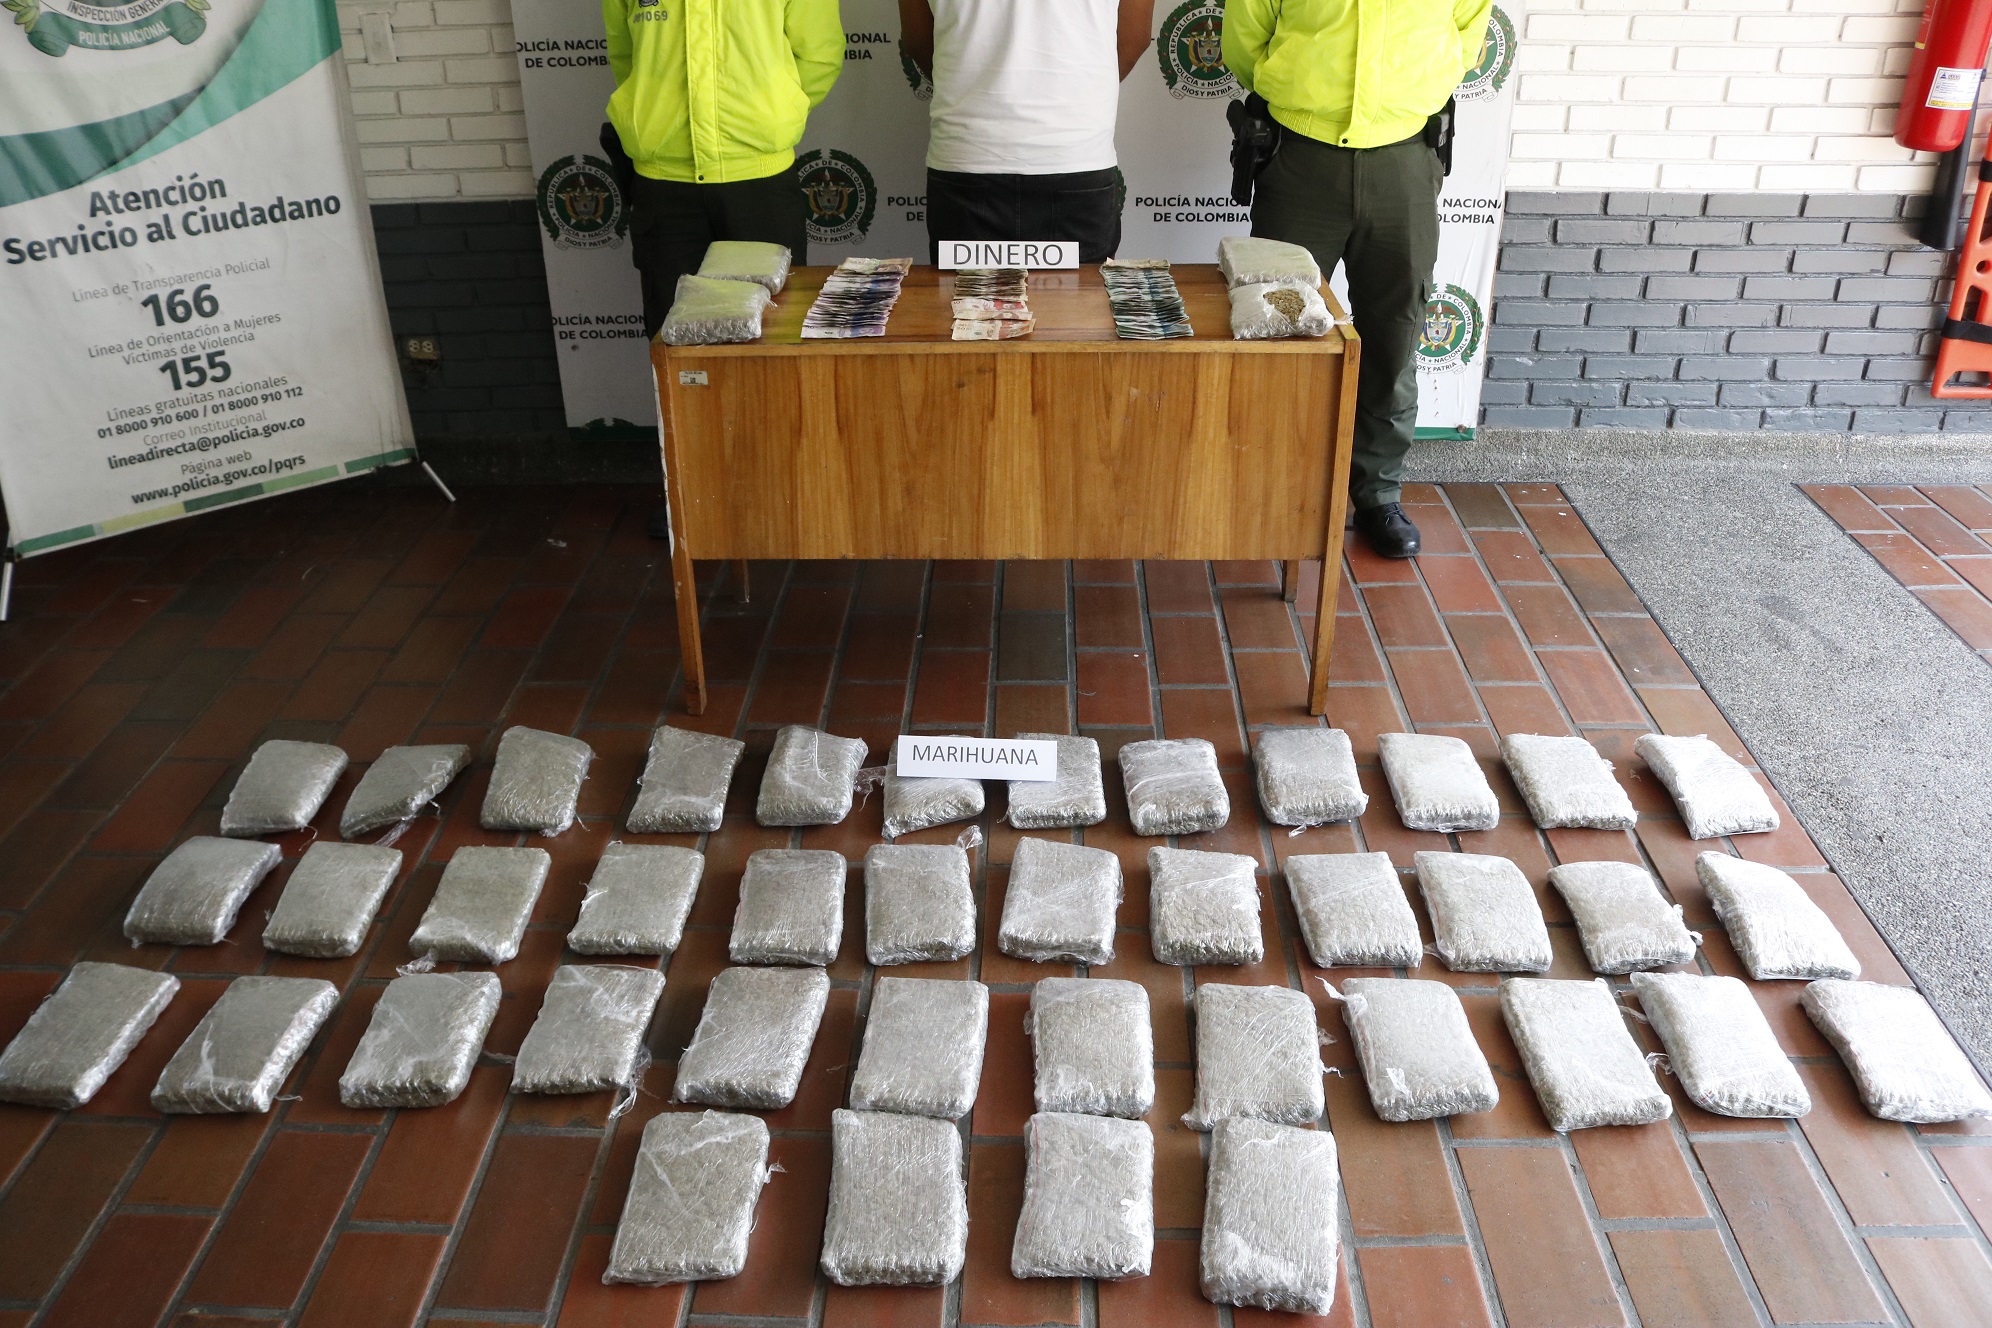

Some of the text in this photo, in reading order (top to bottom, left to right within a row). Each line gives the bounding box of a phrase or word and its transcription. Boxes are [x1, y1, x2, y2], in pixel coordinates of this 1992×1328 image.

[121, 20, 171, 45] NACIONAL
[845, 32, 892, 44] IONAL
[1488, 19, 1505, 57] OLOMBIA
[515, 37, 608, 53] OLICÍA NACIO
[525, 55, 611, 69] DE COLOMB
[1462, 66, 1502, 90] NACIONAL
[1181, 84, 1199, 96] DIOS
[1206, 85, 1233, 97] PATRIA
[1460, 88, 1488, 100] PATRIA
[89, 172, 227, 218] Atención
[594, 169, 620, 207] COLOMBIA
[840, 164, 865, 203] COLOMBIA
[887, 196, 927, 207] POLIC
[1135, 194, 1191, 207] POLICÍA
[587, 215, 619, 238] NACIONAL
[829, 211, 864, 234] NACIONAL
[906, 211, 924, 222] DE
[1153, 212, 1250, 223] DE COLOMBIA
[2, 195, 341, 265] Servicio al Ciudadano
[564, 236, 582, 247] DIOS
[588, 235, 613, 247] PATRIA
[829, 231, 855, 243] PATRIA
[953, 243, 1064, 266] DINERO
[112, 283, 129, 296] de
[132, 266, 222, 292] Transparencia
[225, 257, 271, 276] Policial
[141, 283, 220, 327] 166
[1453, 298, 1472, 335] COLOMBIA
[127, 338, 143, 351] de
[146, 323, 221, 347] Orientación
[223, 321, 231, 333] a
[234, 311, 282, 330] Mujeres
[551, 313, 645, 326] OLICÍA NACION
[181, 342, 196, 355] de
[199, 331, 256, 351] Violencia
[559, 328, 649, 340] DE COLOMBIA
[1433, 342, 1467, 363] NACIONAL
[159, 350, 232, 391] 155
[1432, 362, 1457, 372] PATRIA
[107, 375, 288, 422] Líneas gratuitas nacionales
[97, 427, 113, 439] 01
[115, 421, 148, 436] 8000
[150, 413, 173, 428] 910
[175, 408, 199, 422] 600
[211, 403, 225, 415] 01
[228, 395, 259, 411] 8000
[261, 390, 282, 405] 910
[285, 386, 303, 399] 112
[143, 409, 267, 446] Correo Institucional
[107, 417, 306, 470] lineadirecta@policia.gov.co
[180, 450, 252, 476] Página web
[131, 454, 306, 504] www.policia.gov.co/pqrs
[912, 744, 1039, 766] MARIHUANA
